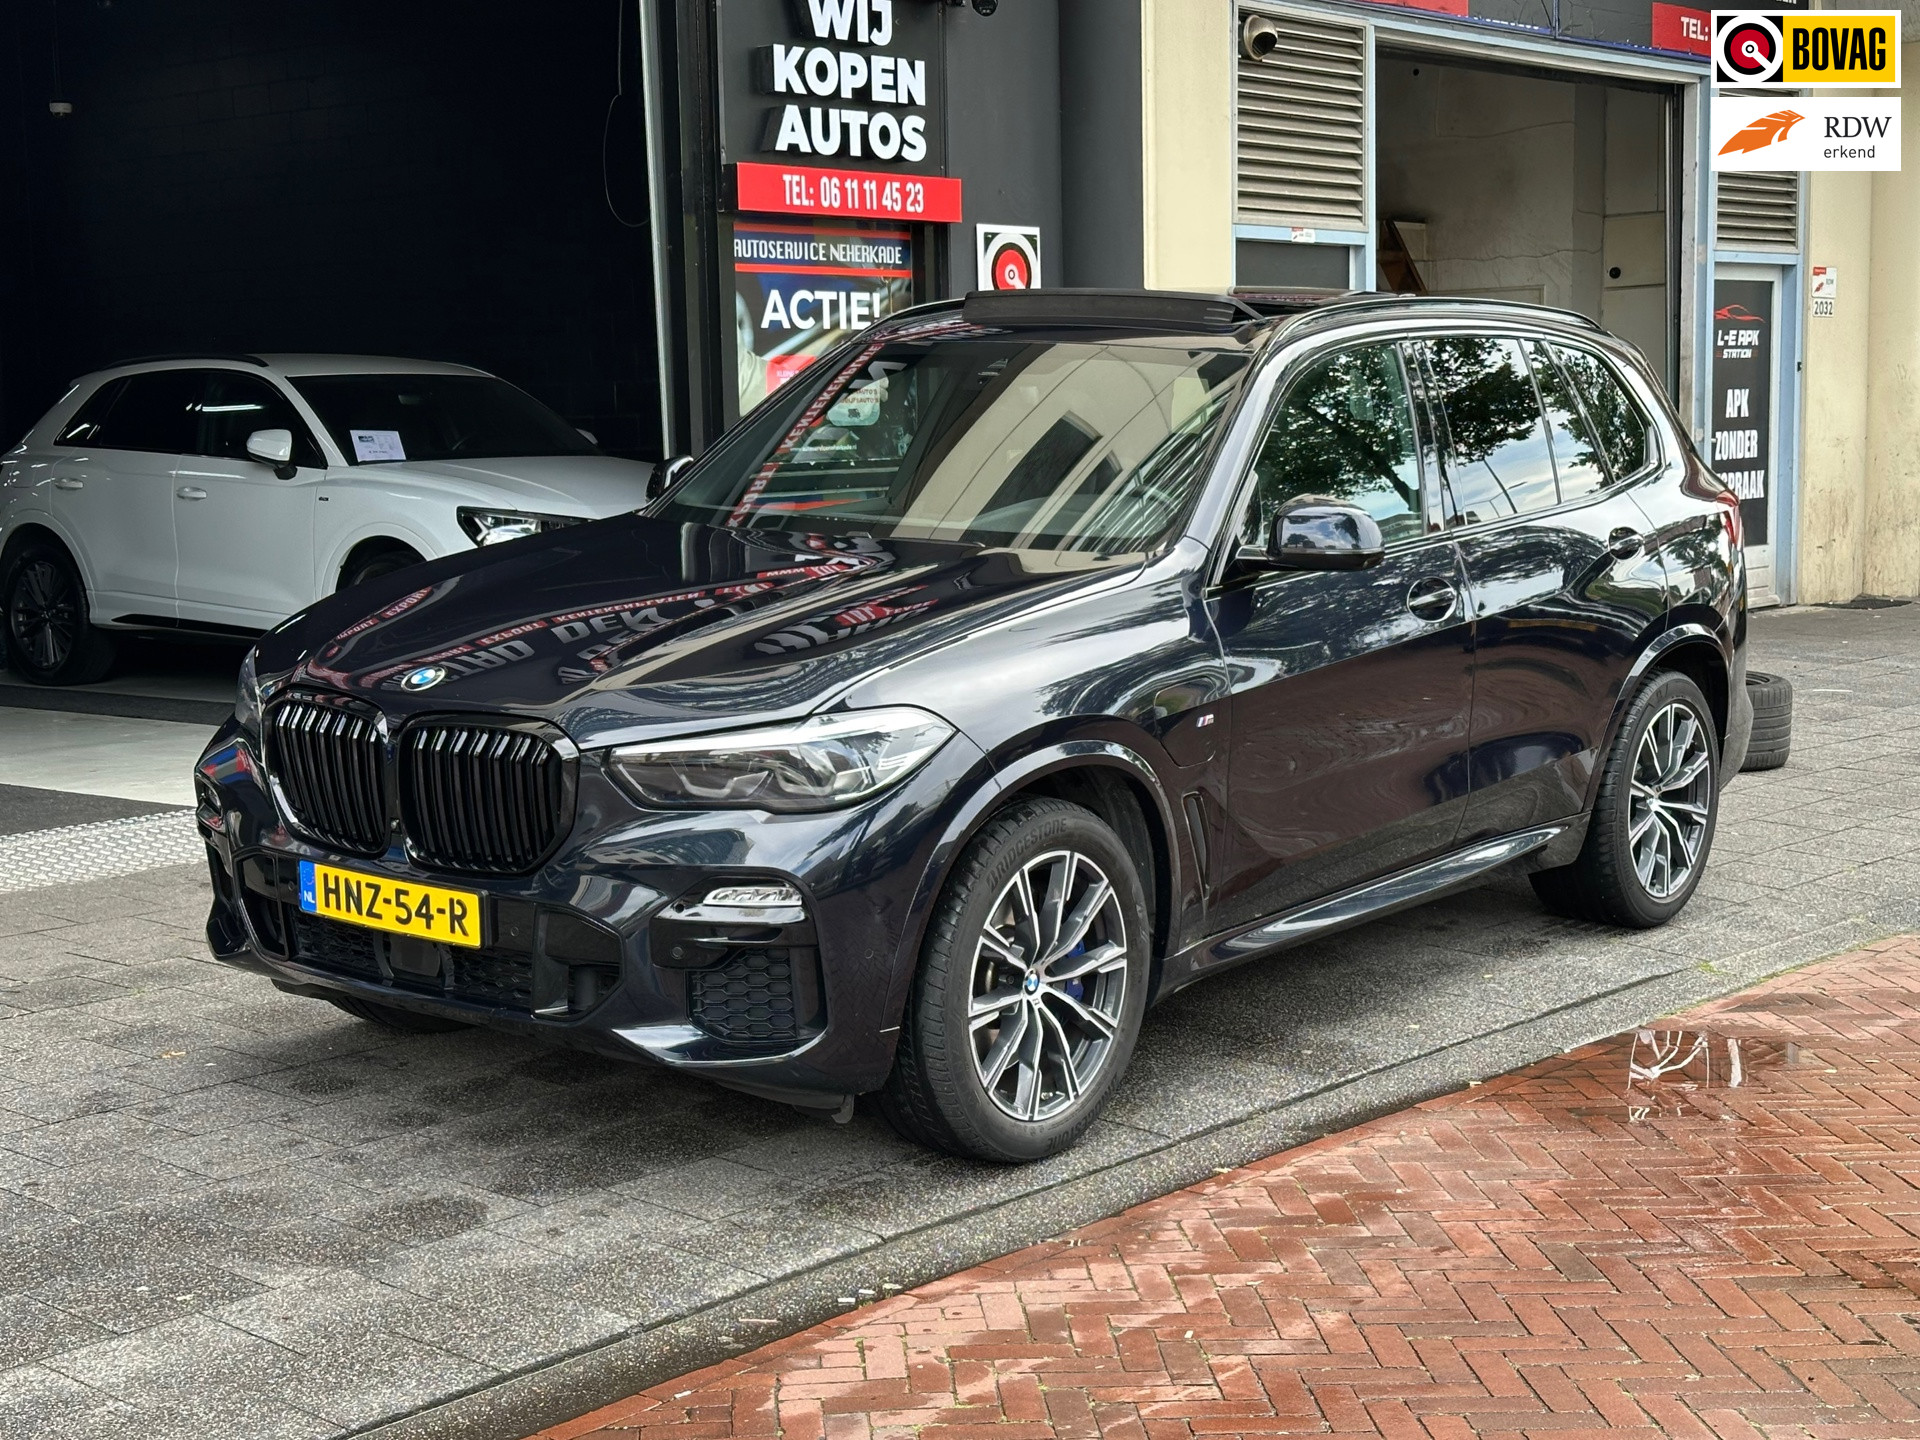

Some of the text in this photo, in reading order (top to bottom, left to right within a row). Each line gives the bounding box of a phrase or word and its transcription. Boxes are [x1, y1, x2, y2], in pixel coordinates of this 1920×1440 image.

[808, 0, 893, 46] WIJ
[1681, 16, 1709, 41] TEL:
[773, 43, 926, 106] KOPEN
[775, 104, 927, 162] AUTOS
[782, 173, 924, 213] TEL: 06 11 11 45 23
[830, 243, 902, 264] NEHERKADE
[760, 289, 880, 330] ACTIE!
[1814, 300, 1833, 315] 2032
[1726, 388, 1749, 418] APK
[1715, 429, 1758, 461] ZONDER
[986, 817, 1067, 893] BRIDGESTONE
[304, 890, 315, 904] NL
[323, 873, 469, 937] HNZ-54-R
